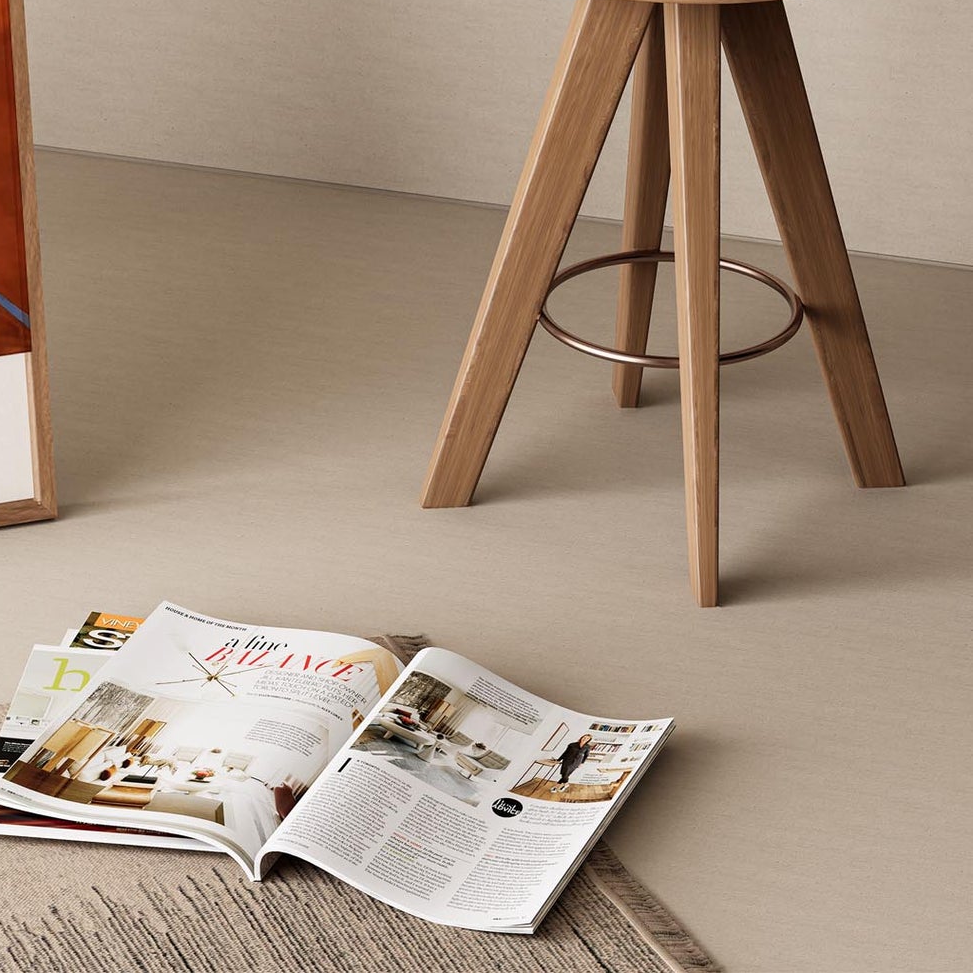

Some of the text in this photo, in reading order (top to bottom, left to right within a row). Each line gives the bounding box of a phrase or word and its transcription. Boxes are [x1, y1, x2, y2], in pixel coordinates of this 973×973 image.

[165, 606, 184, 617] HOUSE
[189, 615, 206, 624] HOME
[225, 624, 247, 632] MONTH
[225, 638, 240, 648] a
[204, 646, 364, 682] BALANCE
[252, 684, 287, 694] TORONTO
[287, 688, 309, 699] SPLIT
[265, 669, 368, 705] DESIGNER AND SHOP OWNER
[279, 681, 307, 693] TOUCH
[322, 685, 342, 698] PUTS
[341, 692, 359, 705] HER
